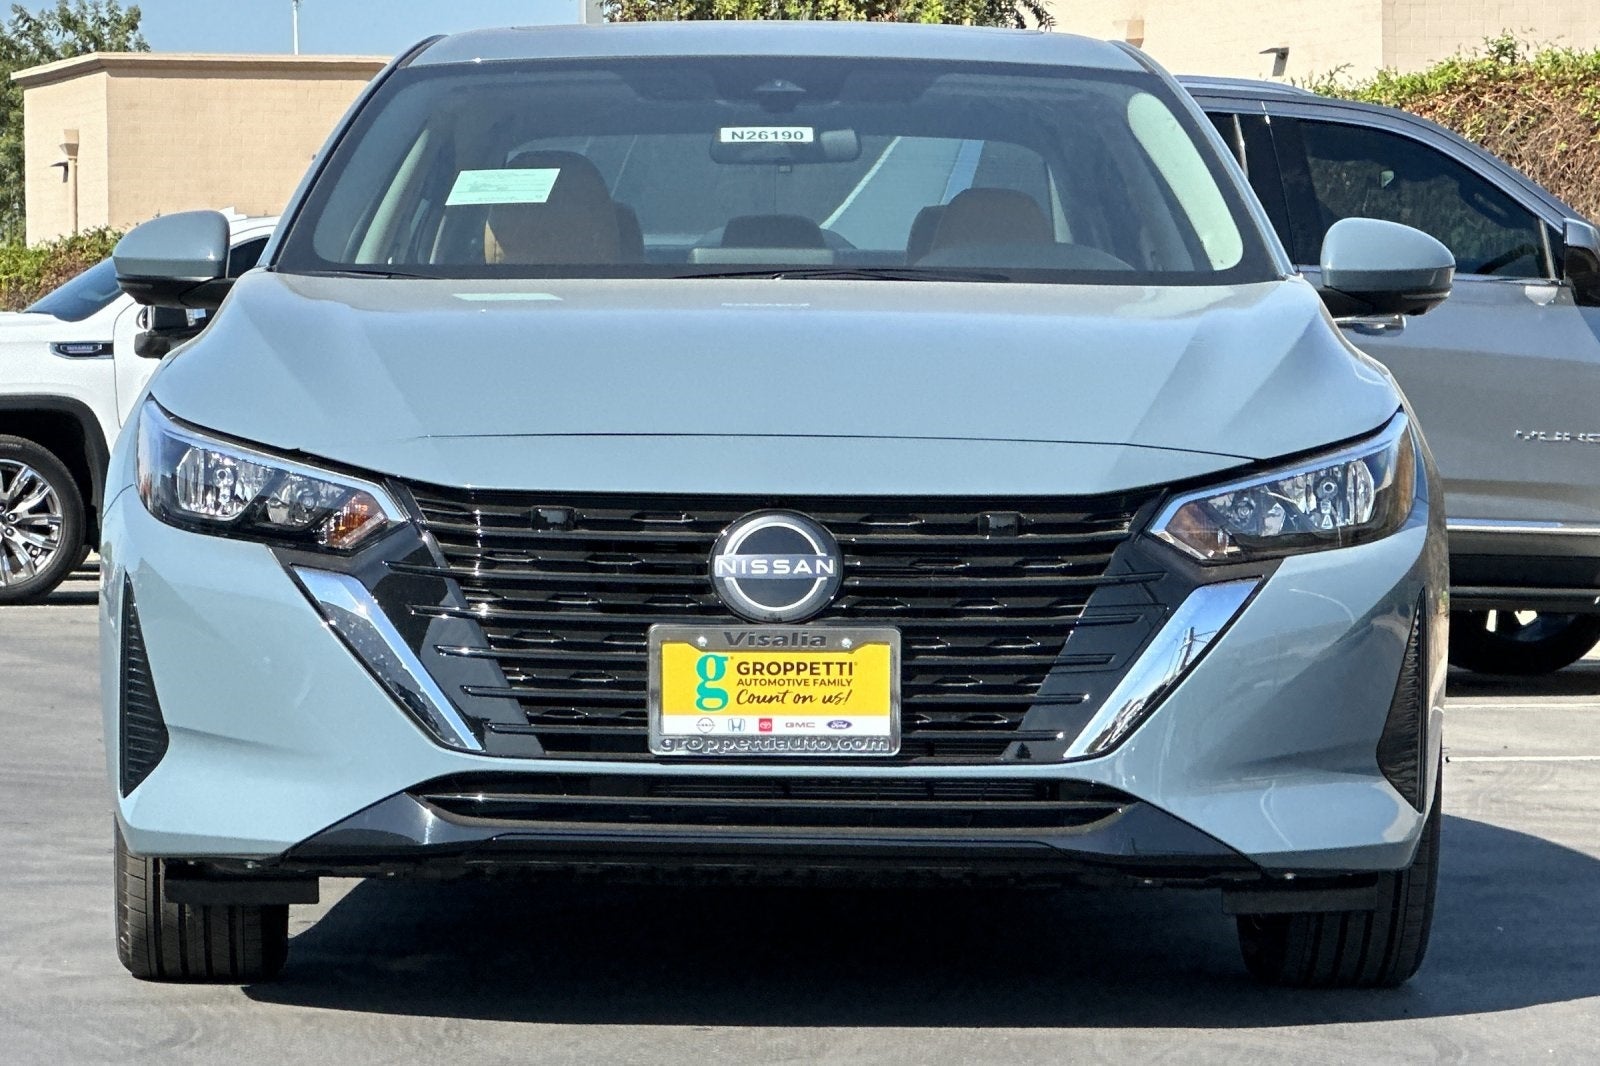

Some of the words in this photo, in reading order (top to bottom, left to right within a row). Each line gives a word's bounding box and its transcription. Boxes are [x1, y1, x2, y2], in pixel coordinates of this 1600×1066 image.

[731, 130, 804, 141] N26190
[719, 559, 834, 574] NISSAN
[723, 631, 827, 647] Visalia
[736, 661, 853, 676] GROPPETTI
[736, 678, 810, 687] AUTOMOTIVE
[812, 678, 853, 687] FAMILY
[736, 689, 793, 705] Count
[793, 693, 818, 704] on
[821, 689, 853, 705] us!
